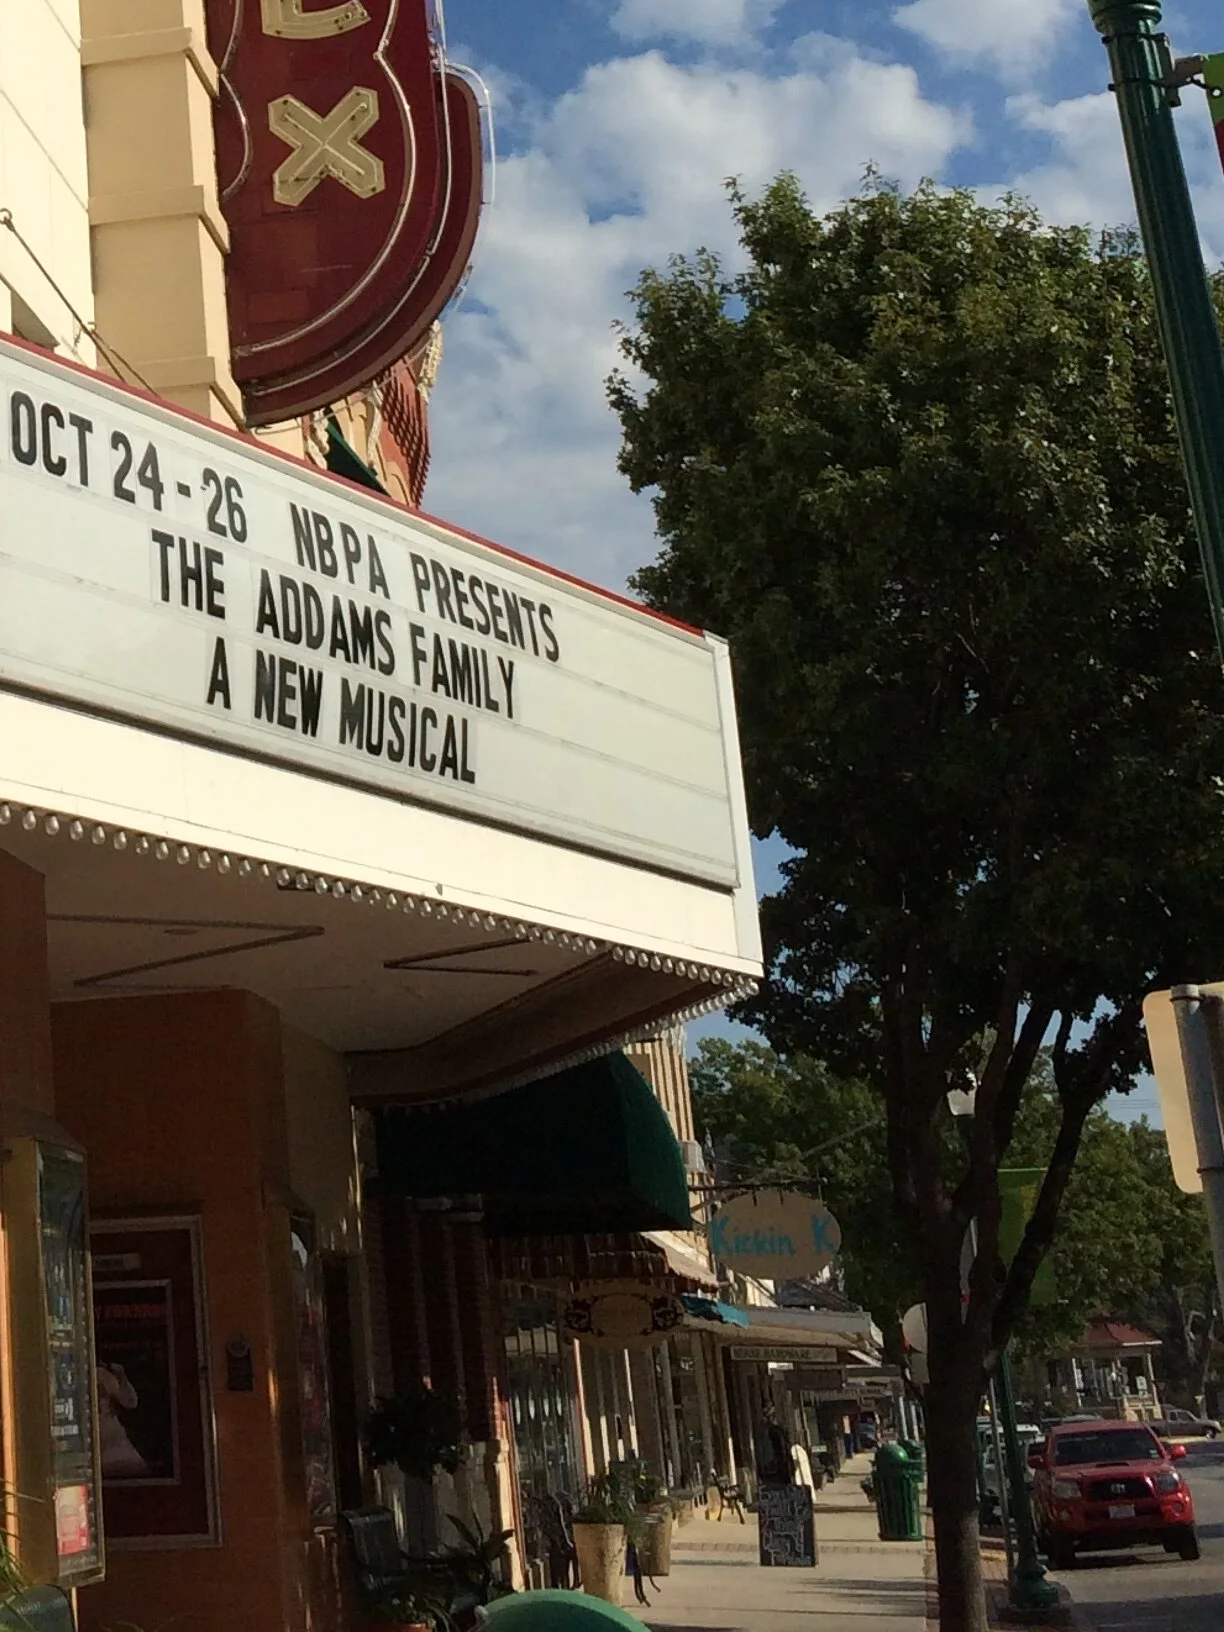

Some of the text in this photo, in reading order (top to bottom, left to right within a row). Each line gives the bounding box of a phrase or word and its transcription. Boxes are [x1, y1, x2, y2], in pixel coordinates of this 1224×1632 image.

[10, 389, 92, 485] OCT
[289, 502, 390, 598] NBPA
[409, 551, 560, 661] PRESENTS
[152, 530, 516, 718] THE ADDAMS FAMILY
[206, 636, 476, 783] A NEW MUSICAL
[811, 1214, 835, 1255] K
